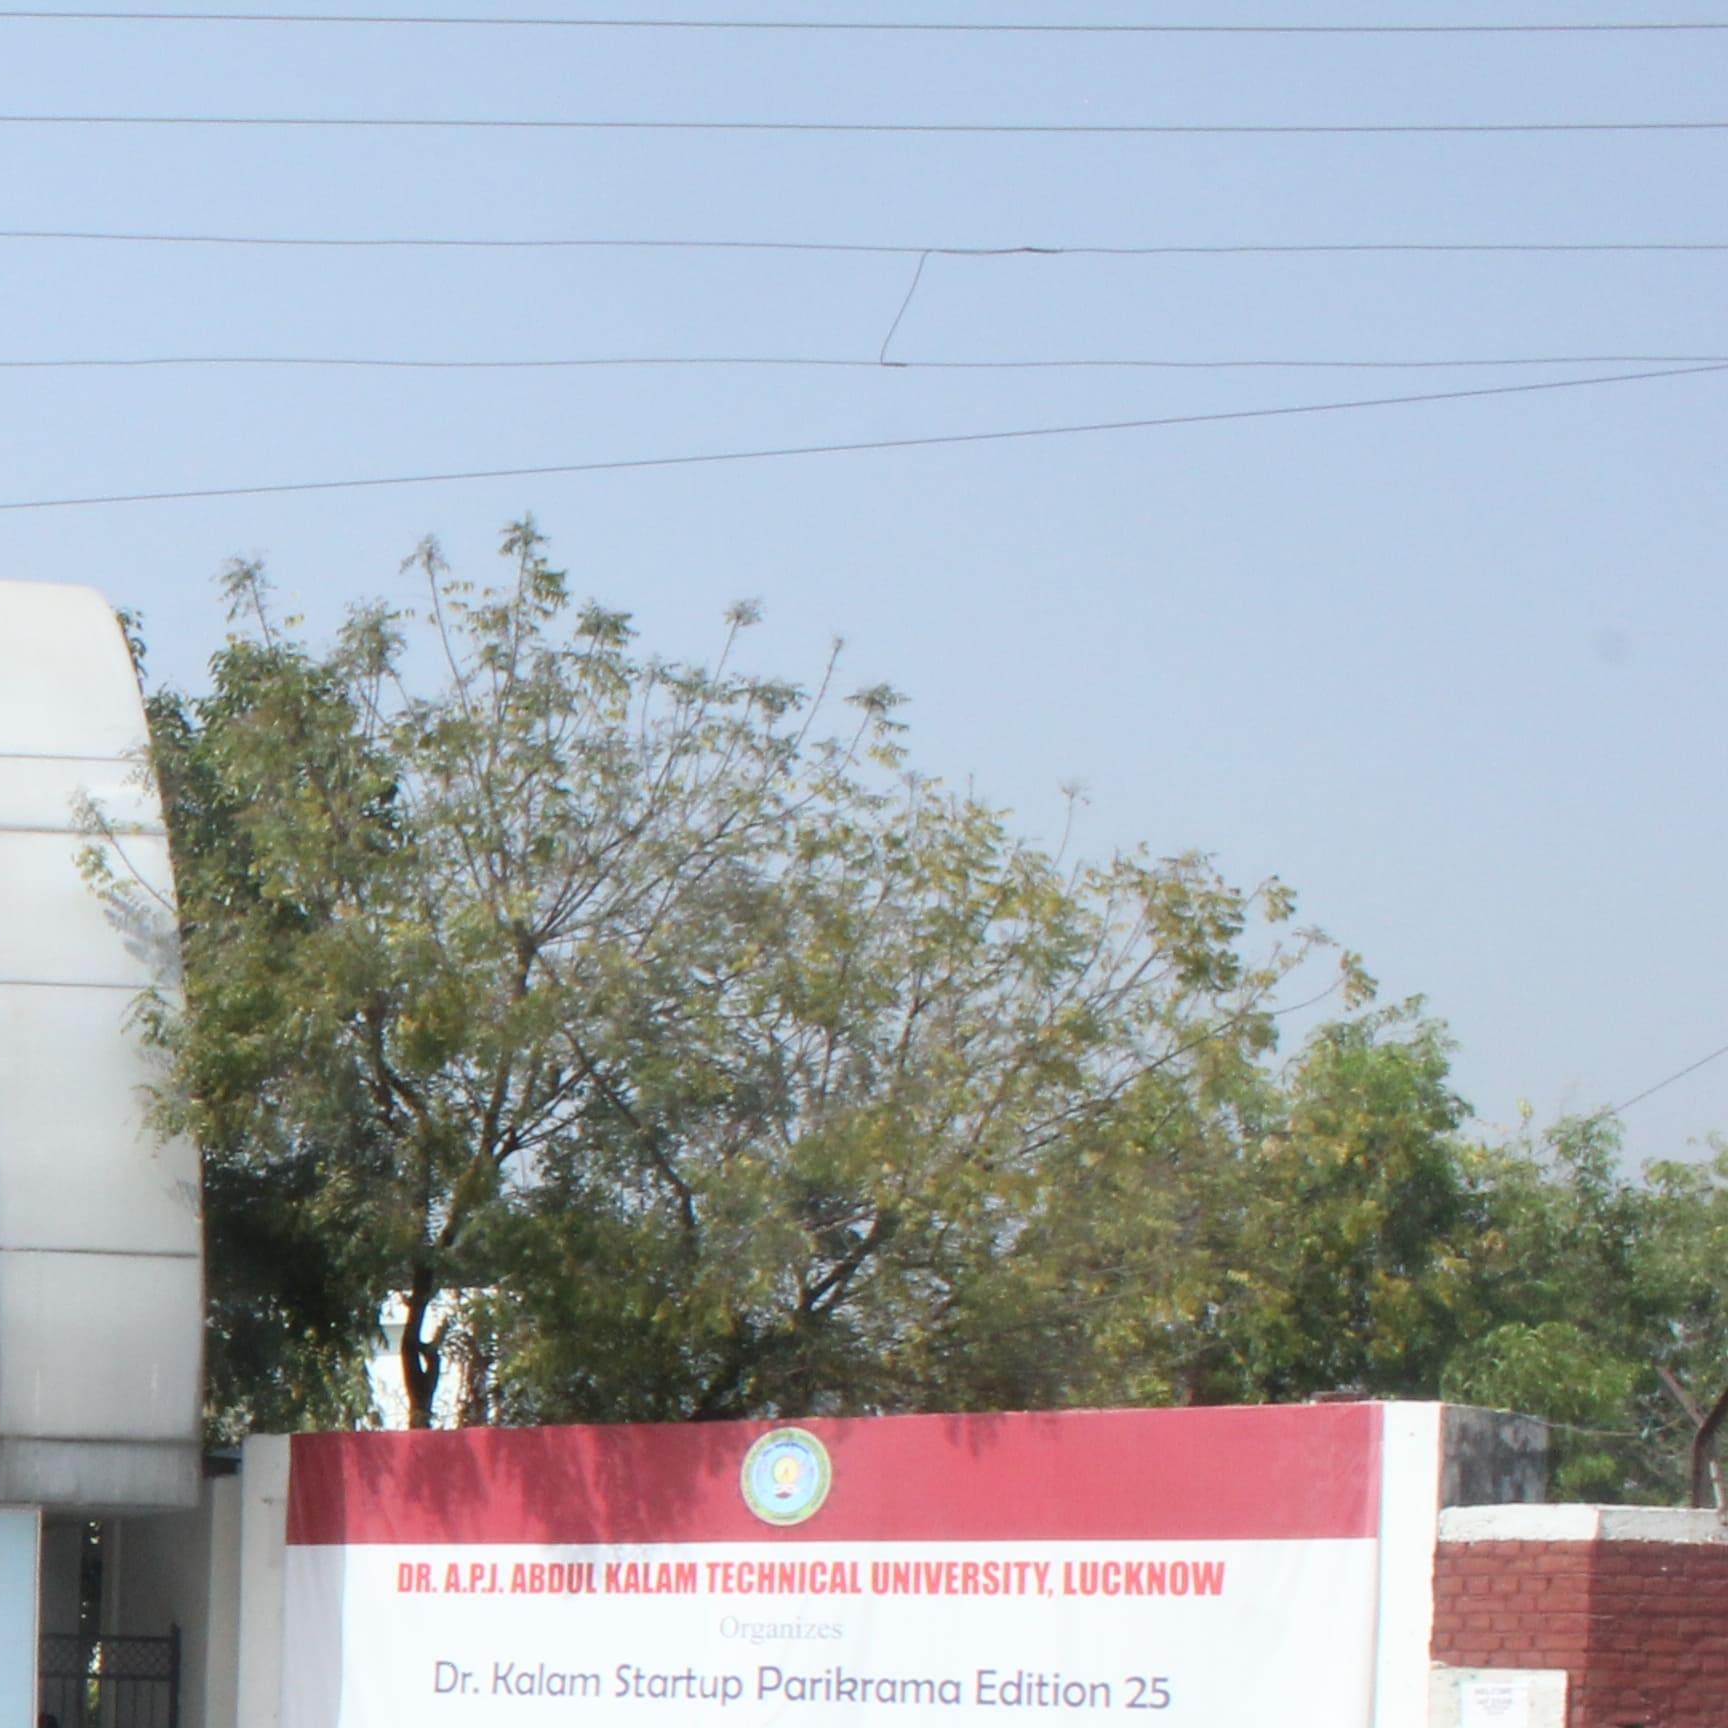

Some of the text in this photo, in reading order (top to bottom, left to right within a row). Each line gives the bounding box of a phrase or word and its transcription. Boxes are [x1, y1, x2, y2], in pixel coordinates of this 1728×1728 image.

[397, 1561, 1225, 1598] DR. A.P.J. ABDUL KALAM TECHNICAL UNIVERSITY, LUCKNOW
[719, 1615, 843, 1645] Organizes
[434, 1661, 1171, 1709] Dr. Kalam Startup Parikrama Edition 25
